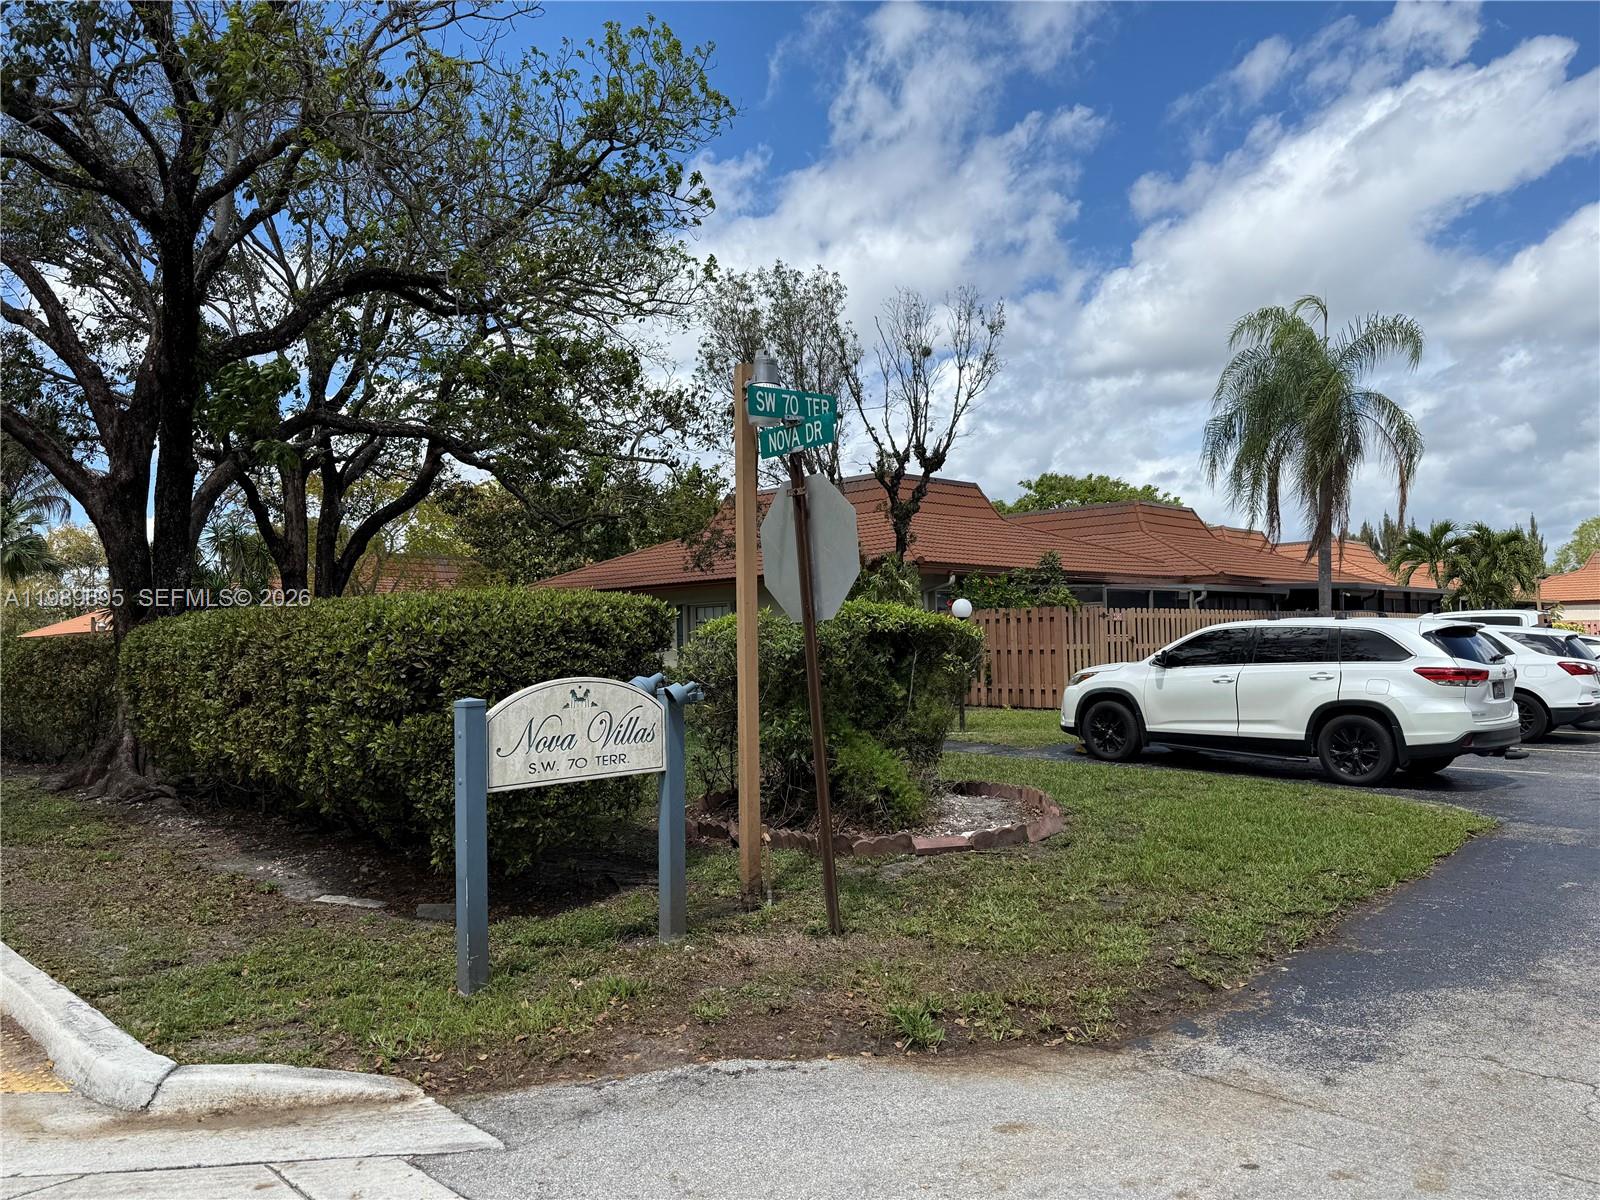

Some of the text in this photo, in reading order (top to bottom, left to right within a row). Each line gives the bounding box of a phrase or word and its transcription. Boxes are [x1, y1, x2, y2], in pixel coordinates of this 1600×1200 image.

[756, 391, 830, 416] SW 70 TER
[768, 420, 823, 453] NOVA DR
[496, 705, 656, 758] Nova Villas
[528, 753, 630, 774] S.W. 70 TERR.
